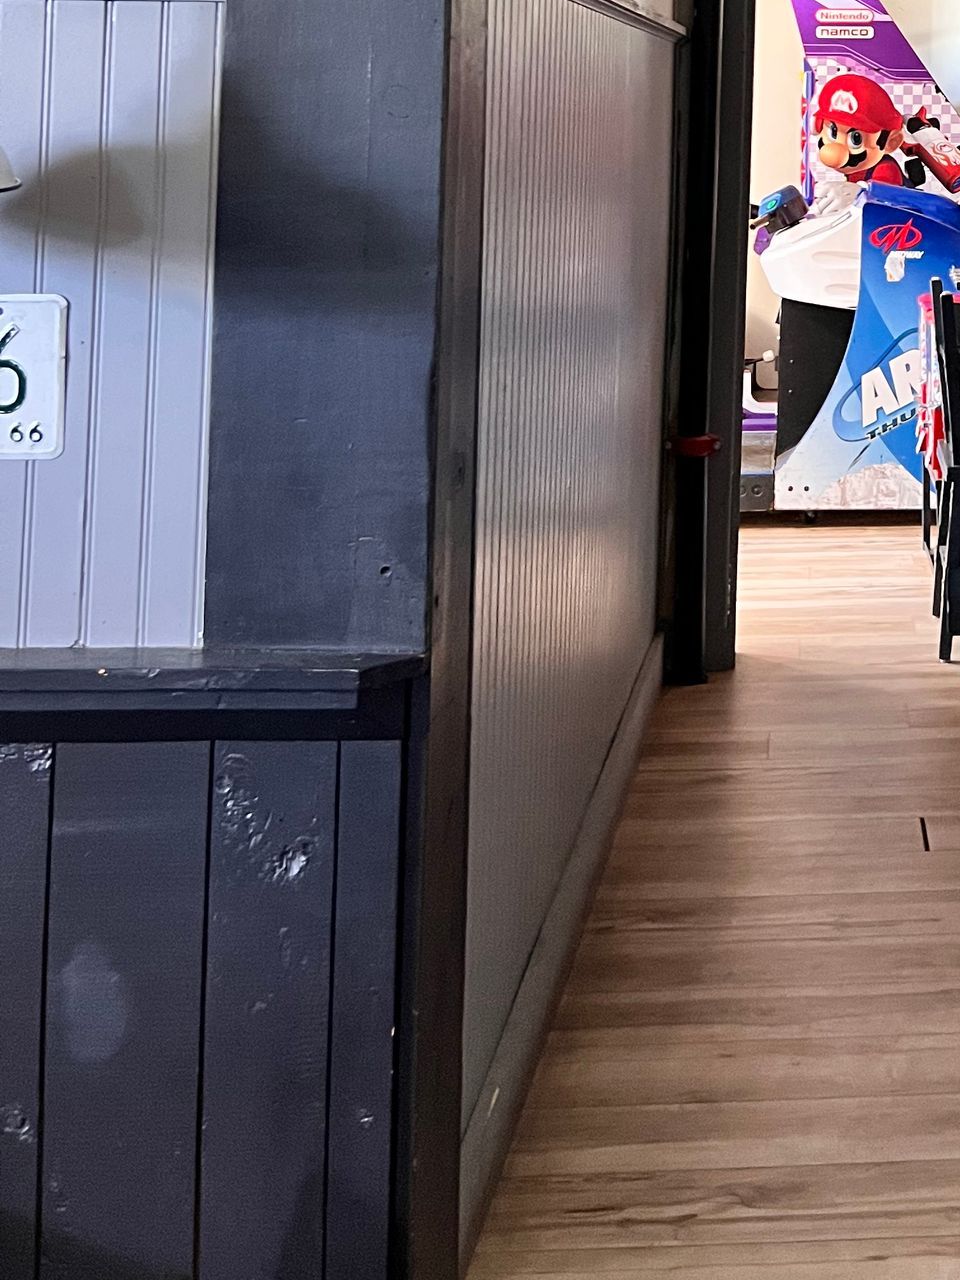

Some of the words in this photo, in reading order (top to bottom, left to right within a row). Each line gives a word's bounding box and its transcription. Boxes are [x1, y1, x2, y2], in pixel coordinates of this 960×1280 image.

[820, 11, 869, 21] Nintendo
[820, 28, 869, 37] namco
[10, 421, 43, 443] 66
